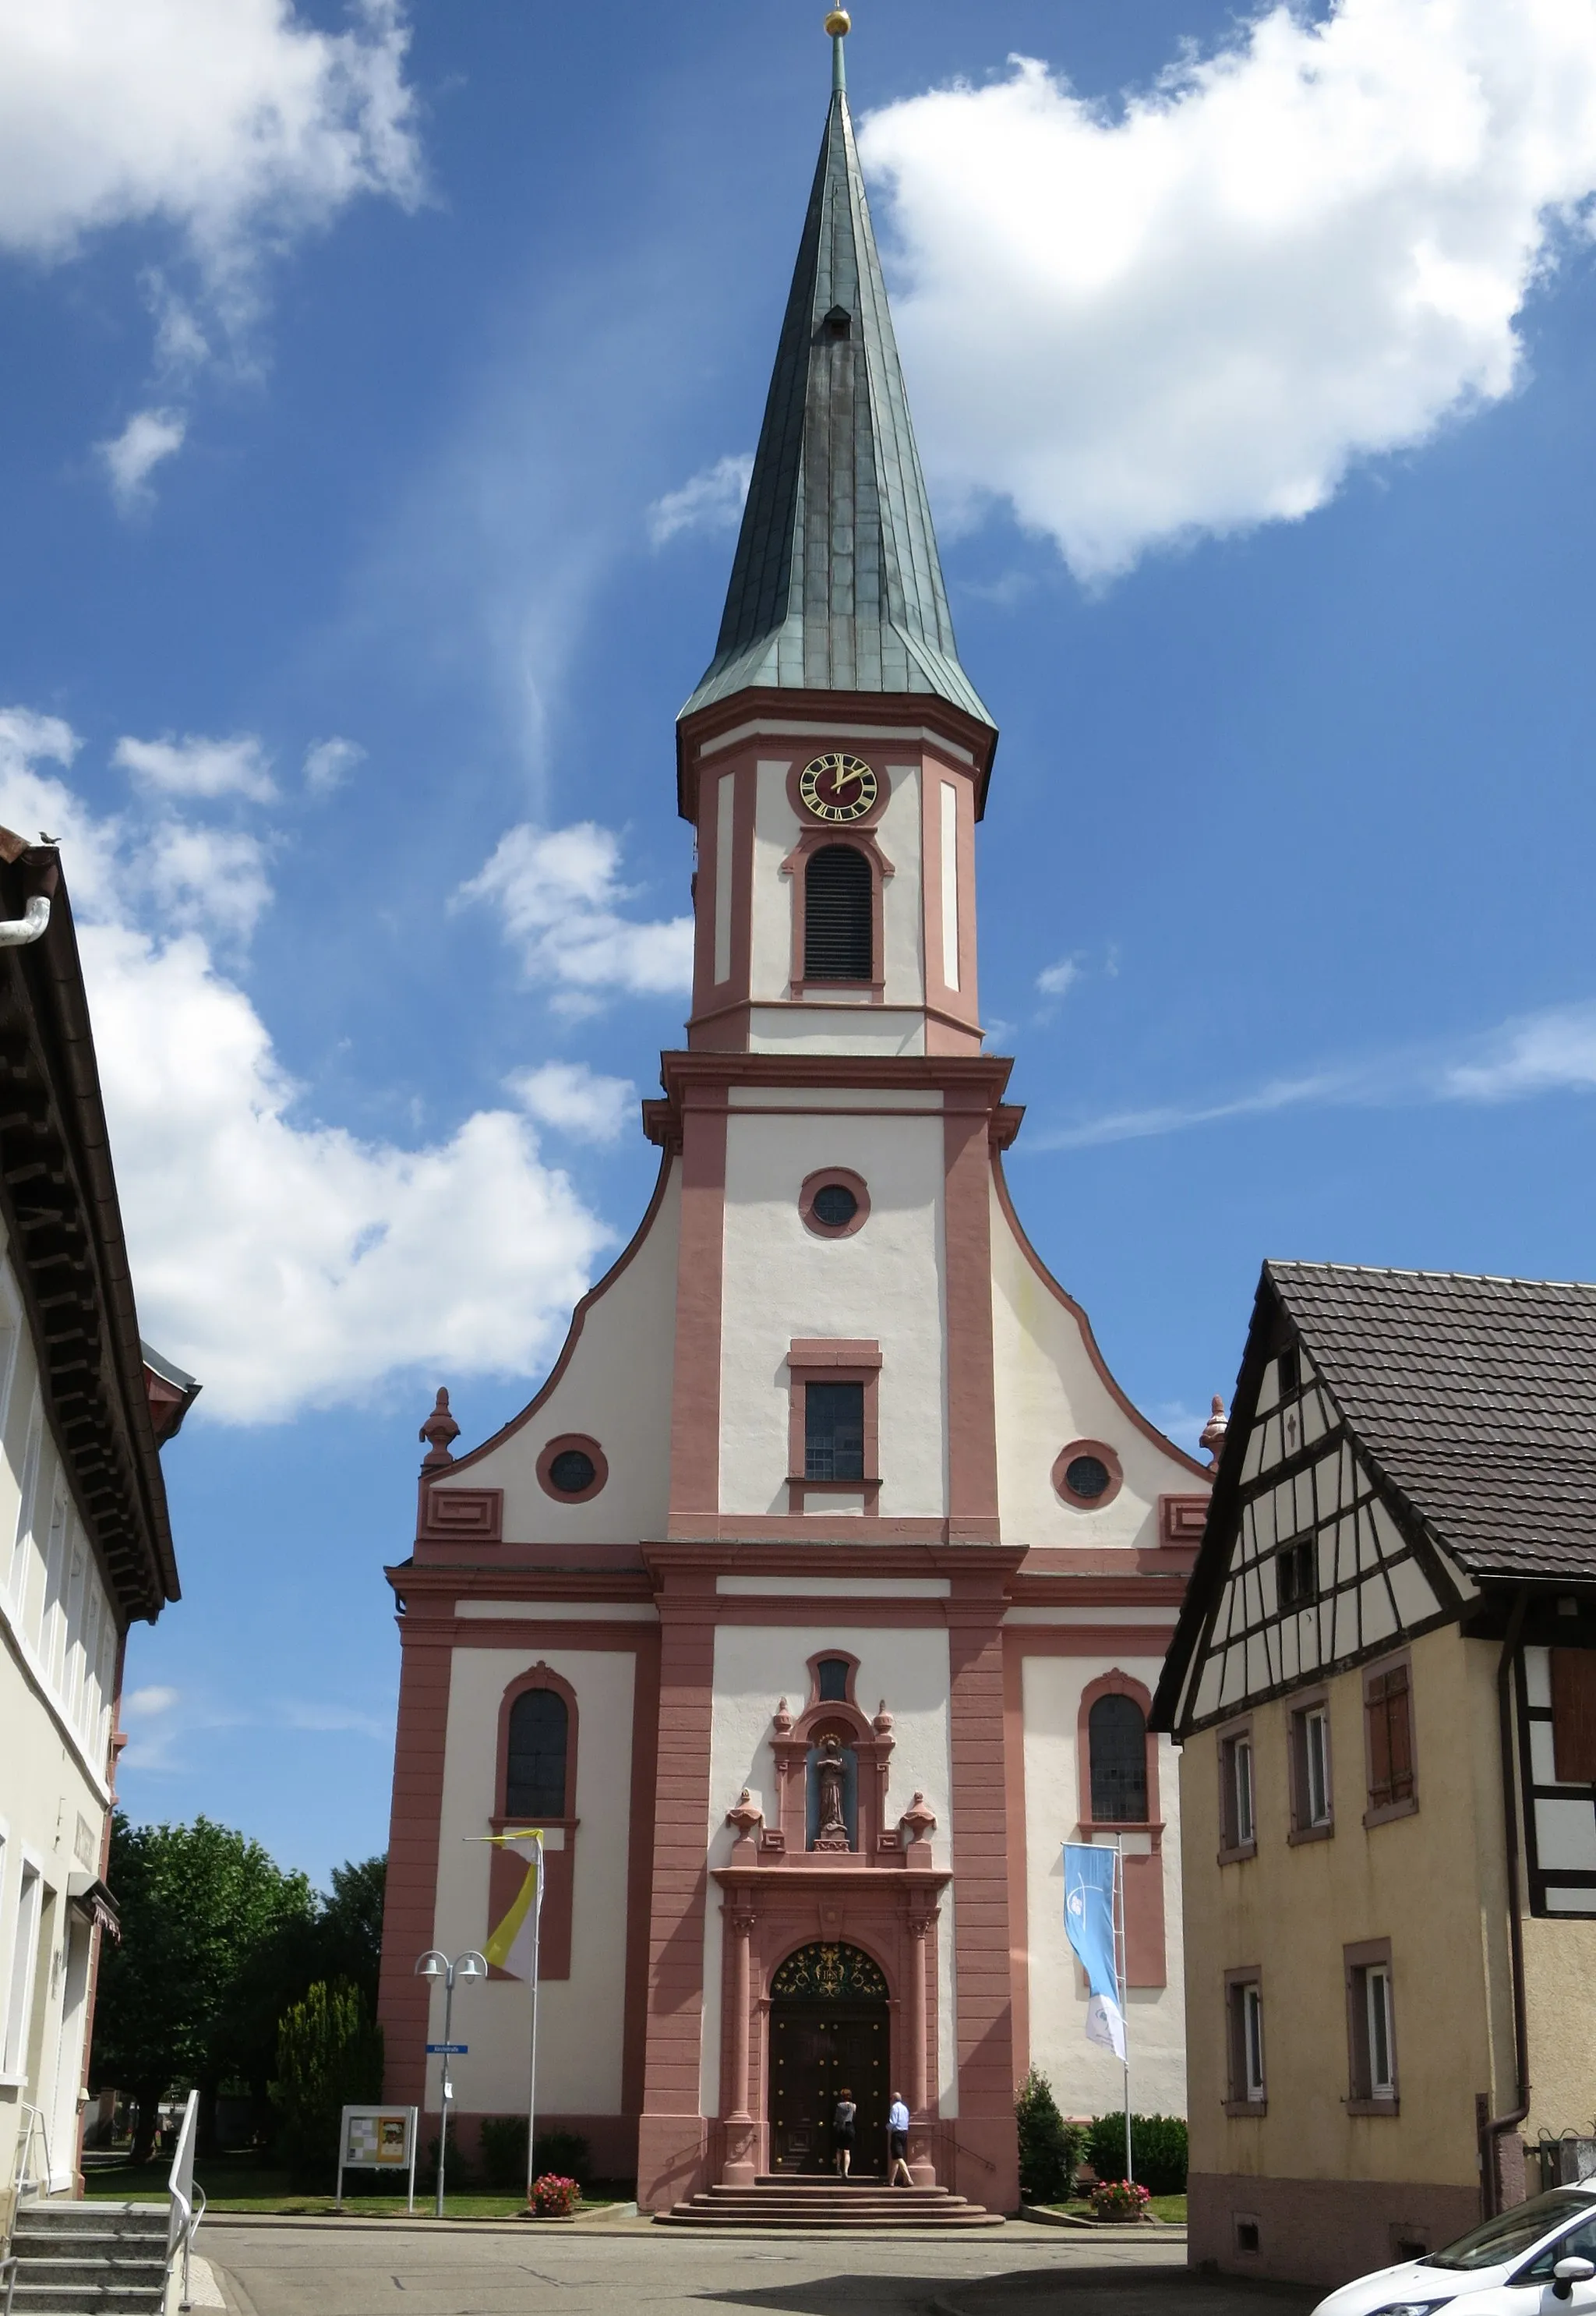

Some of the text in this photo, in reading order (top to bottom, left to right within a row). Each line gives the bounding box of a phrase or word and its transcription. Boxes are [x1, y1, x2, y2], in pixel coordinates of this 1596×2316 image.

[817, 756, 829, 769] XI
[850, 759, 858, 769] I
[805, 767, 819, 777] X
[803, 793, 818, 806] VIII
[816, 803, 828, 818] VII
[835, 808, 843, 820] VI
[851, 806, 860, 817] V
